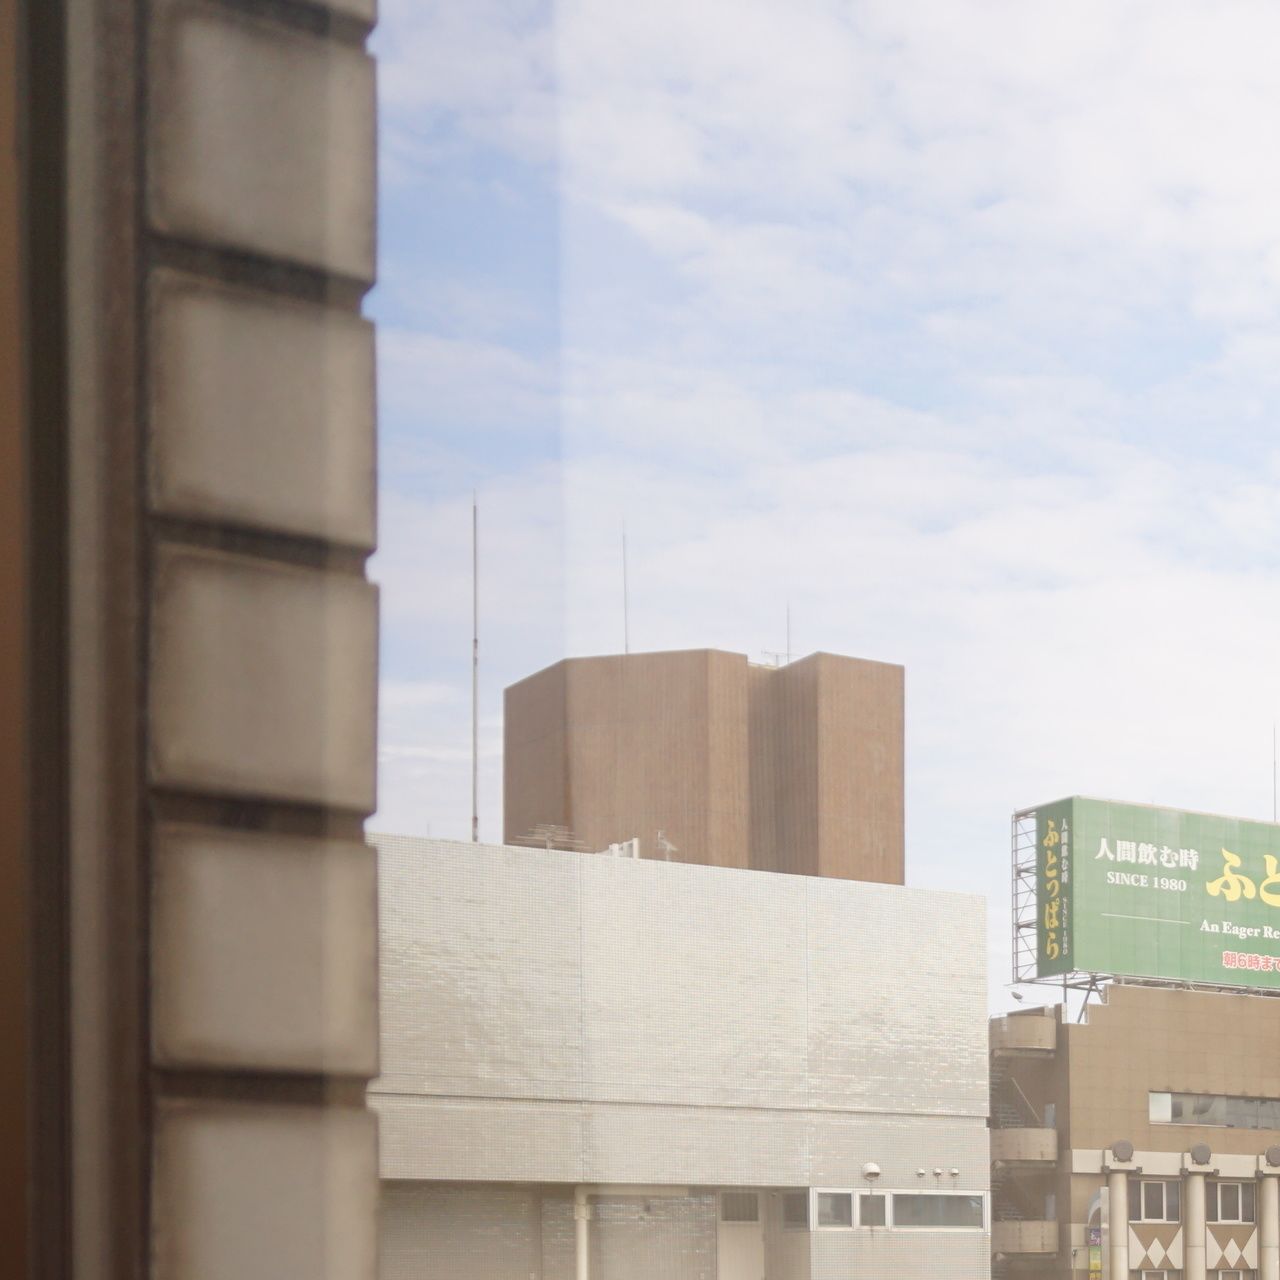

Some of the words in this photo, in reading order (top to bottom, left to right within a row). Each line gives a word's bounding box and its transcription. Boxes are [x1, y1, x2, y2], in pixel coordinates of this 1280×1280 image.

[1094, 837, 1199, 872] 人間飲む時
[1107, 871, 1149, 889] SINCE
[1153, 876, 1187, 892] 1980
[1200, 919, 1220, 933] An
[1222, 921, 1261, 940] Eager
